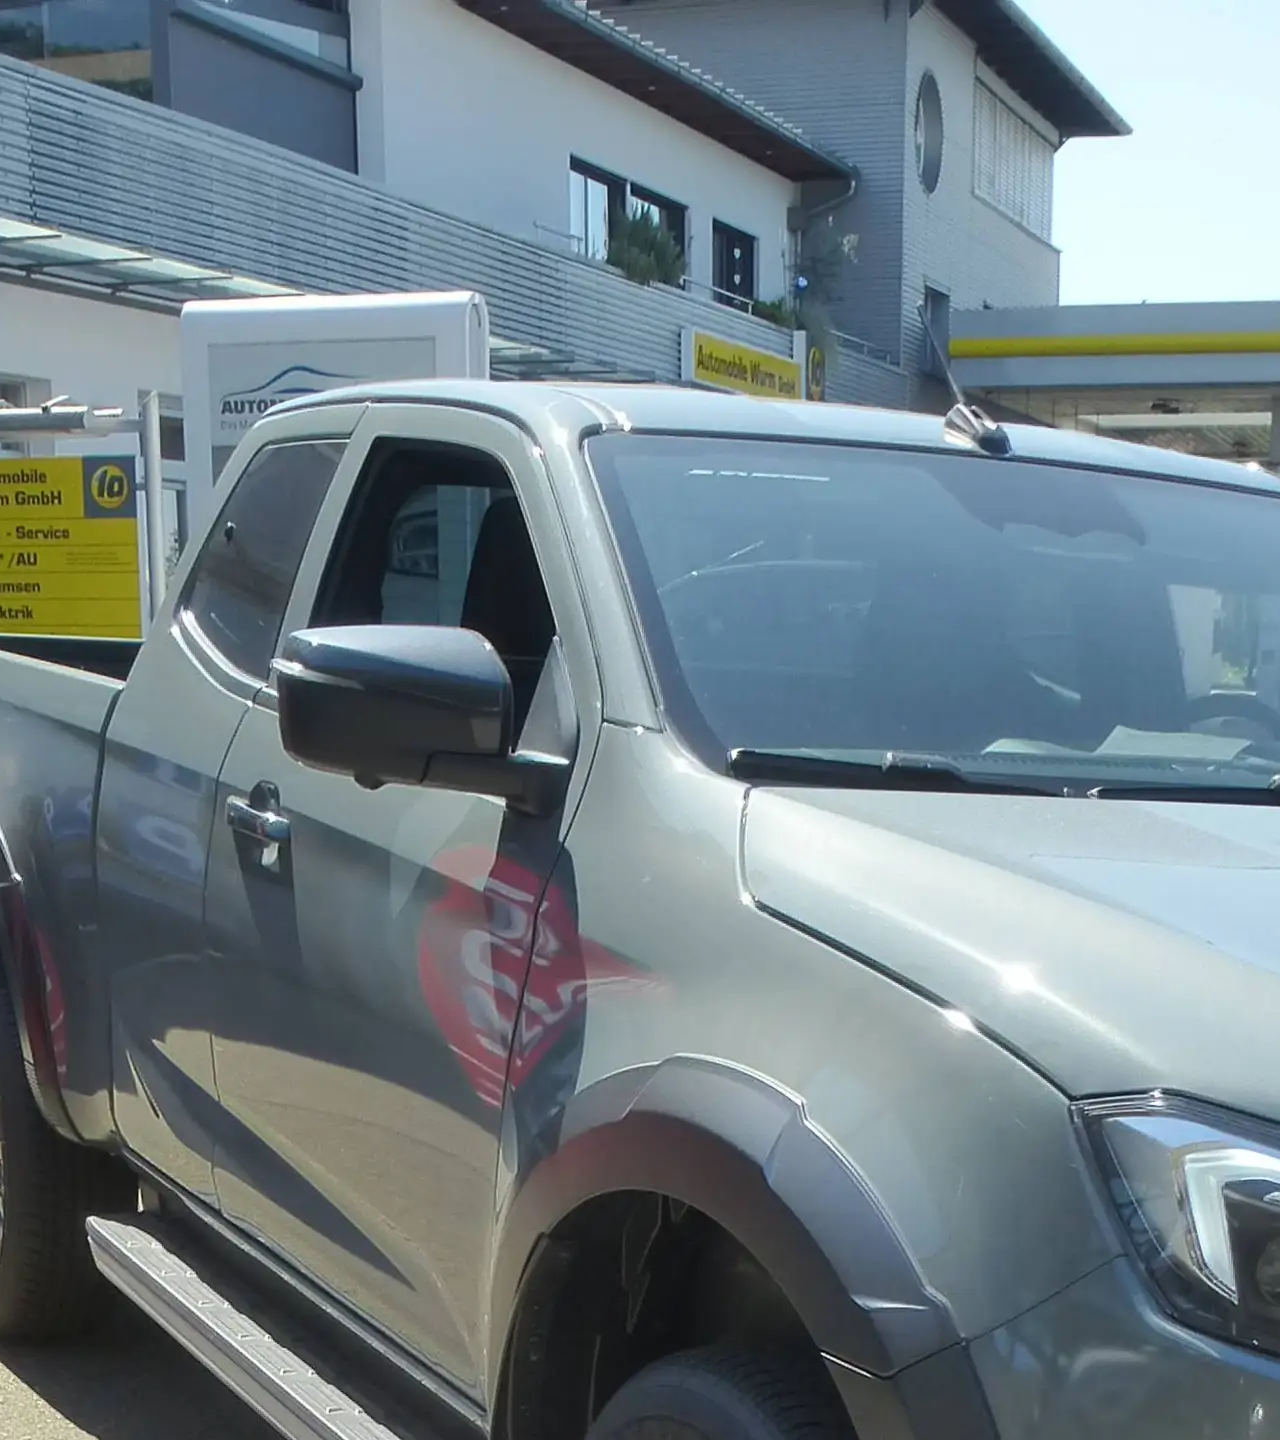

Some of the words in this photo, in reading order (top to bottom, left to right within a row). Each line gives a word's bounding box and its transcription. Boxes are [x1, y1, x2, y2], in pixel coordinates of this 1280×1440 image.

[697, 344, 748, 382] Automobile
[15, 490, 62, 506] GmbH
[15, 525, 70, 540] Service
